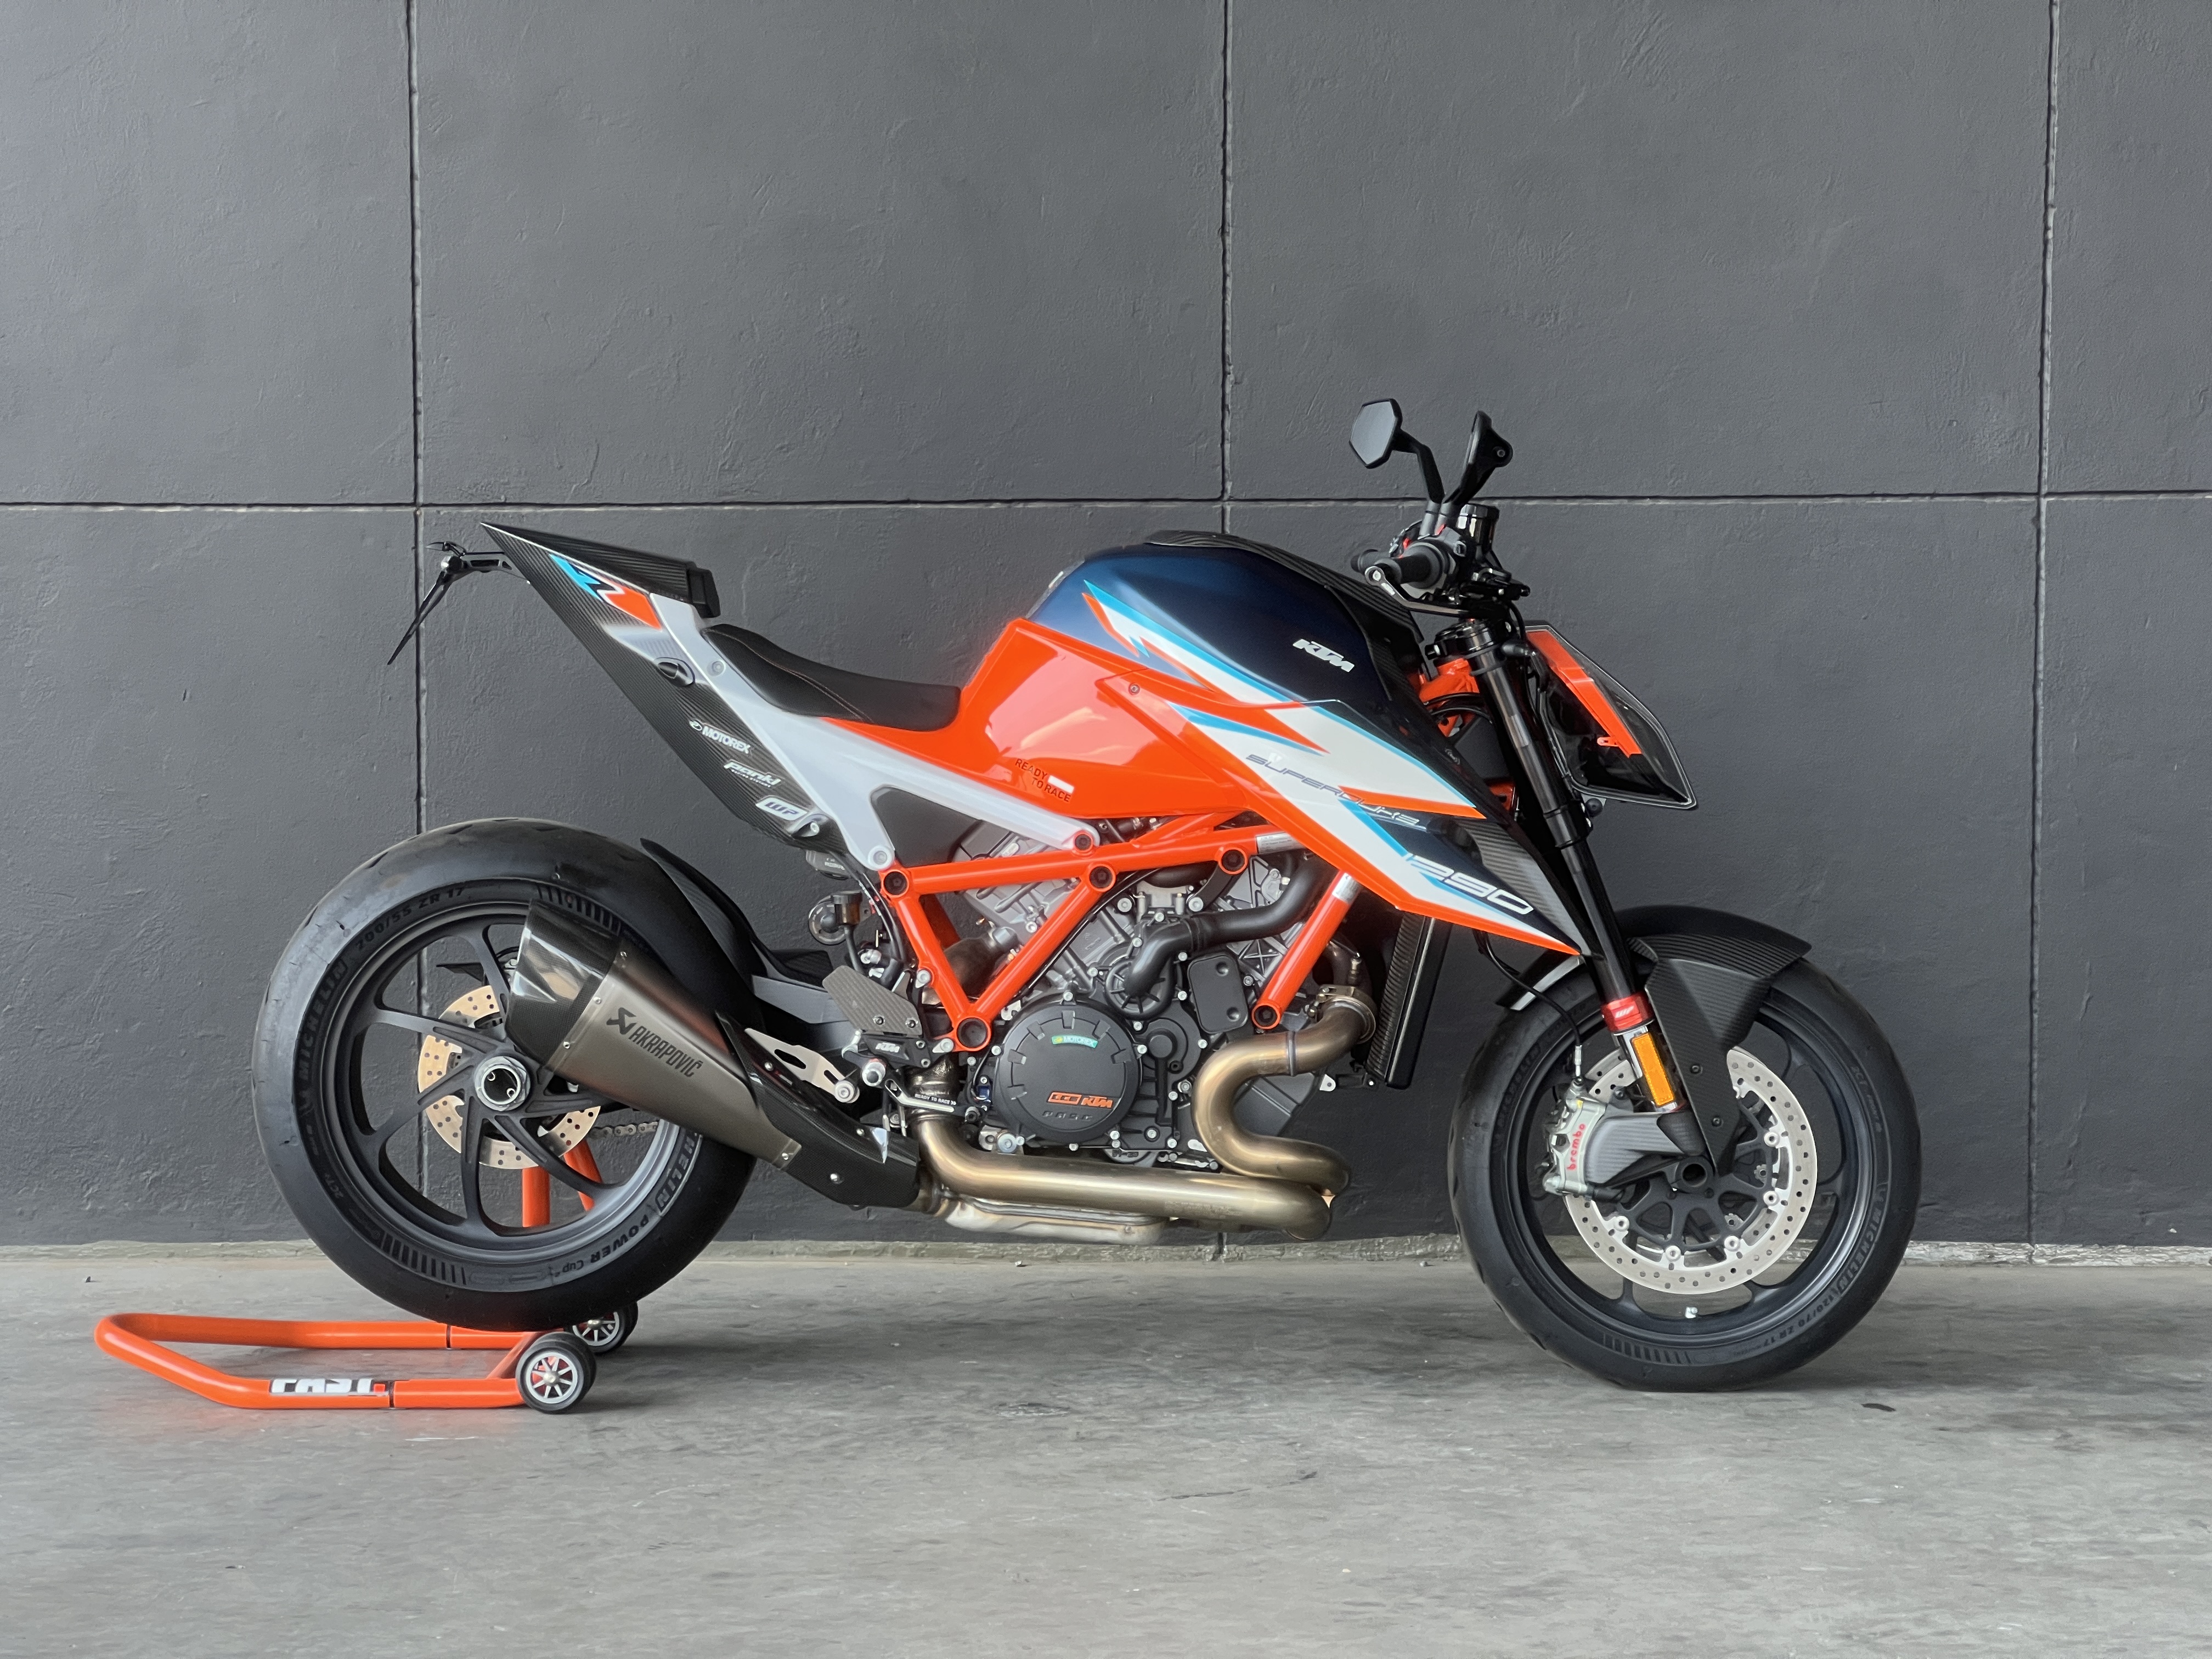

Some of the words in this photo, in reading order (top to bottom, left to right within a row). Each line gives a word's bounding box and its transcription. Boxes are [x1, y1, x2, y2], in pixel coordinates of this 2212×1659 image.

[1293, 639, 1355, 673] KTM
[702, 725, 751, 754] MOTOREX
[1014, 758, 1048, 780] READY
[1031, 776, 1044, 789] TO
[1044, 783, 1071, 802] RACE
[417, 891, 441, 909] ZR
[446, 887, 465, 899] 17
[298, 961, 347, 1081] MICHELIN
[875, 1042, 900, 1053] KTM
[1063, 1034, 1097, 1048] MOTOREX
[1081, 1095, 1114, 1109] KTM
[590, 1214, 650, 1263] POWER
[1838, 1206, 1882, 1291] MICHELIN
[1763, 1337, 1776, 1347] 17
[1779, 1326, 1795, 1339] ZR
